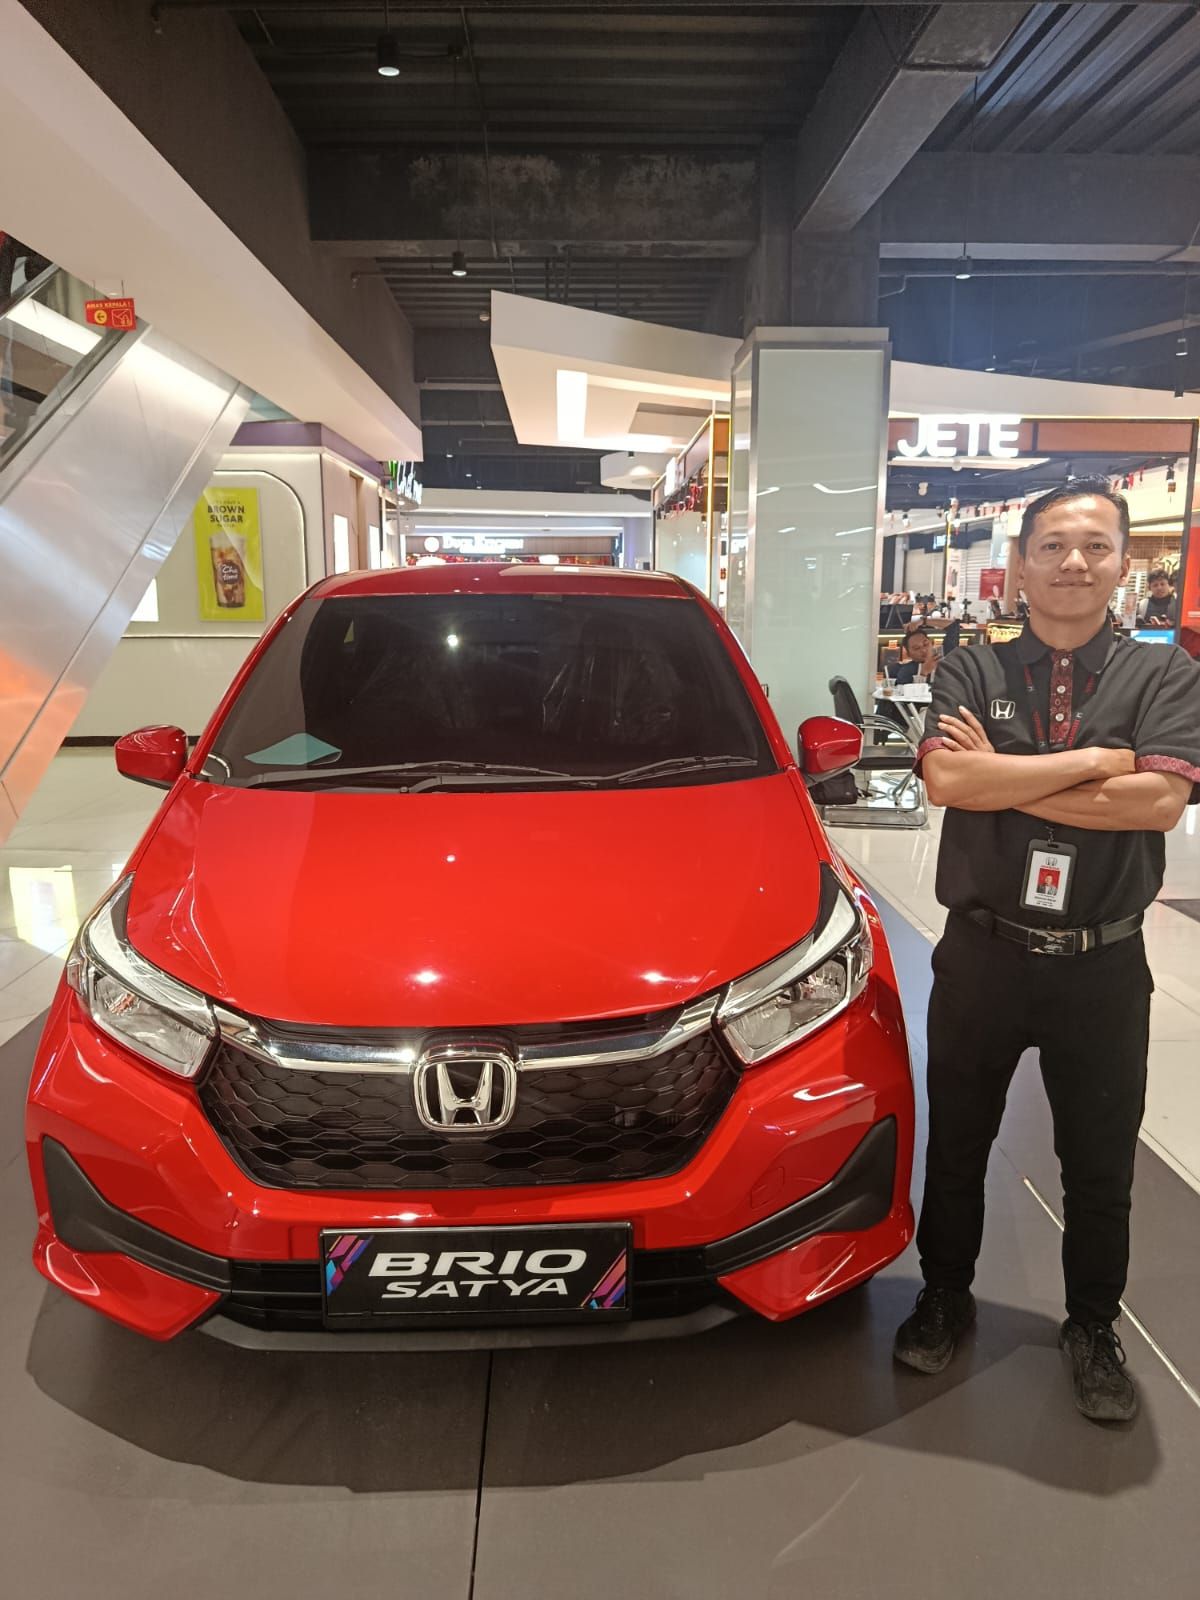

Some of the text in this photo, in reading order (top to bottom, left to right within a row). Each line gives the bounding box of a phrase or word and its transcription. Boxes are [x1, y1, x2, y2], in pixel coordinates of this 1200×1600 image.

[897, 413, 1021, 457] JETE
[207, 505, 245, 514] BROWN
[210, 514, 244, 523] SUGAR
[368, 1249, 587, 1277] BRIO
[381, 1278, 569, 1299] SATYA
